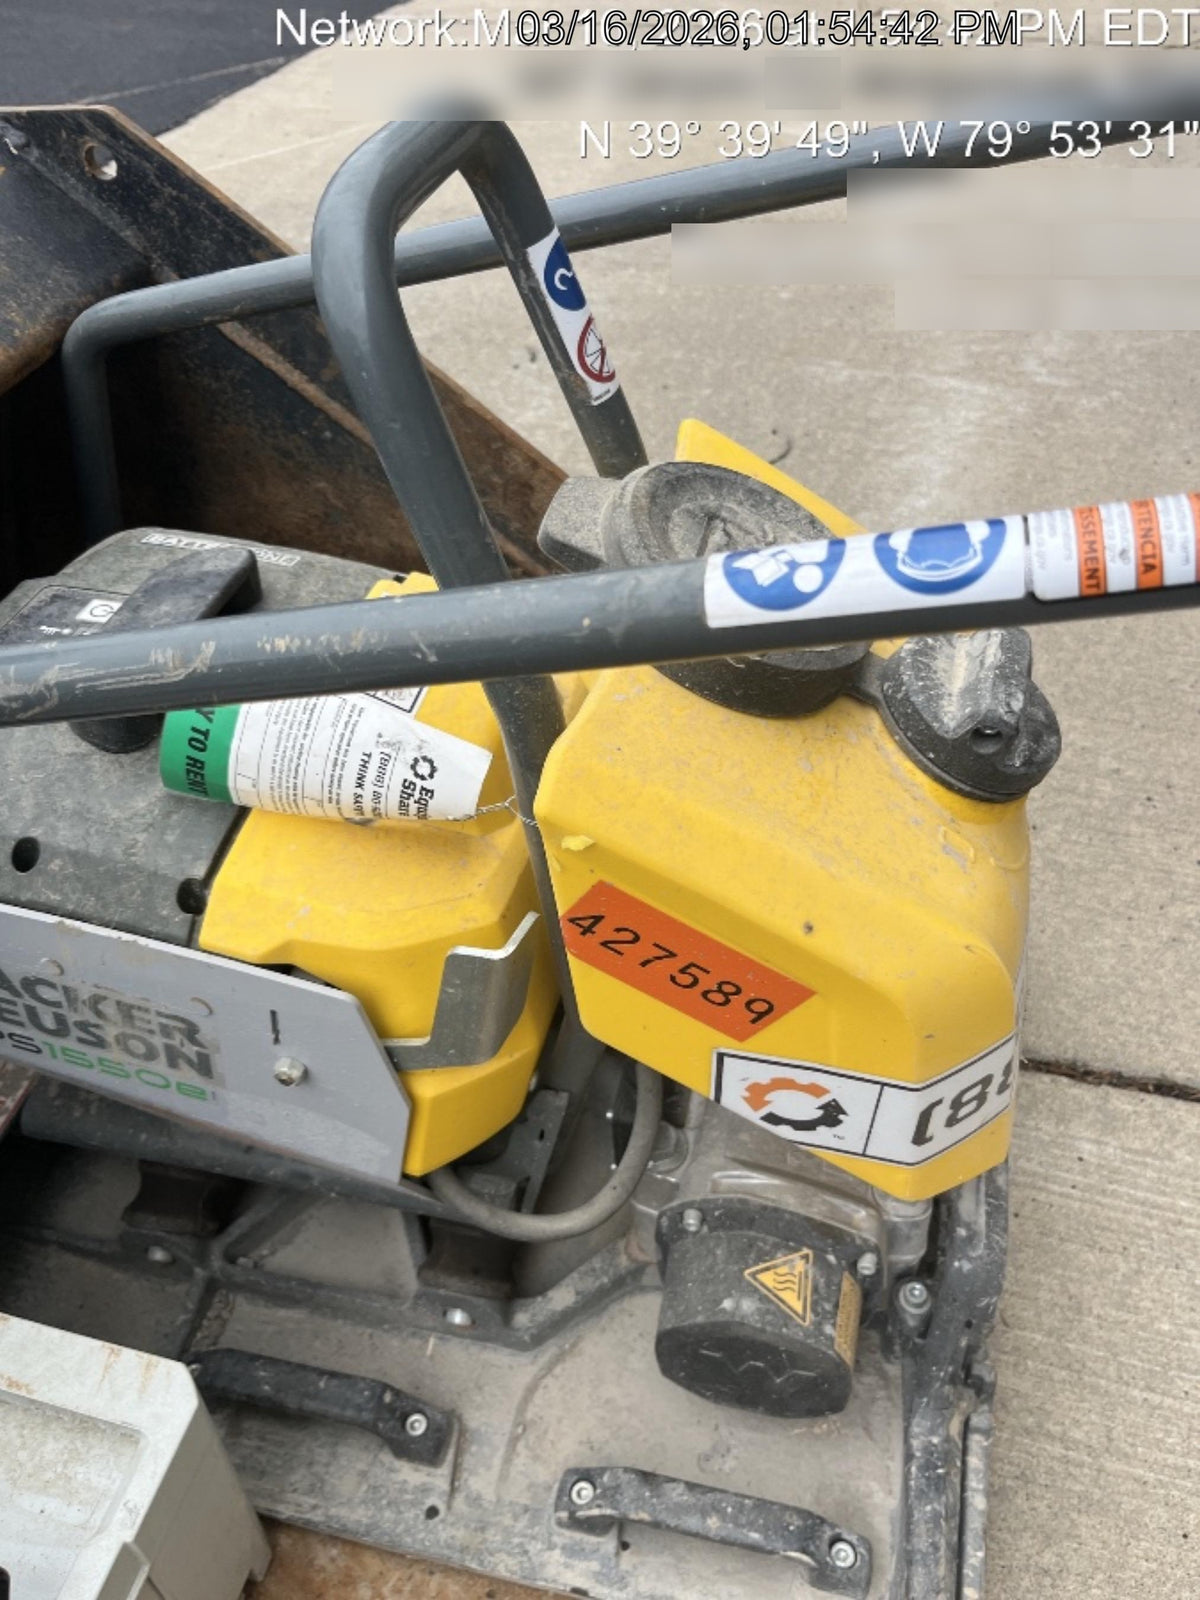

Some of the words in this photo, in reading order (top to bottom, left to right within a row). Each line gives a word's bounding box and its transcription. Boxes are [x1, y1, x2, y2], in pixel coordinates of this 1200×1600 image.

[187, 726, 211, 753] TO
[185, 755, 209, 797] RENT
[355, 751, 372, 792] THINK
[567, 914, 775, 1024] 427589
